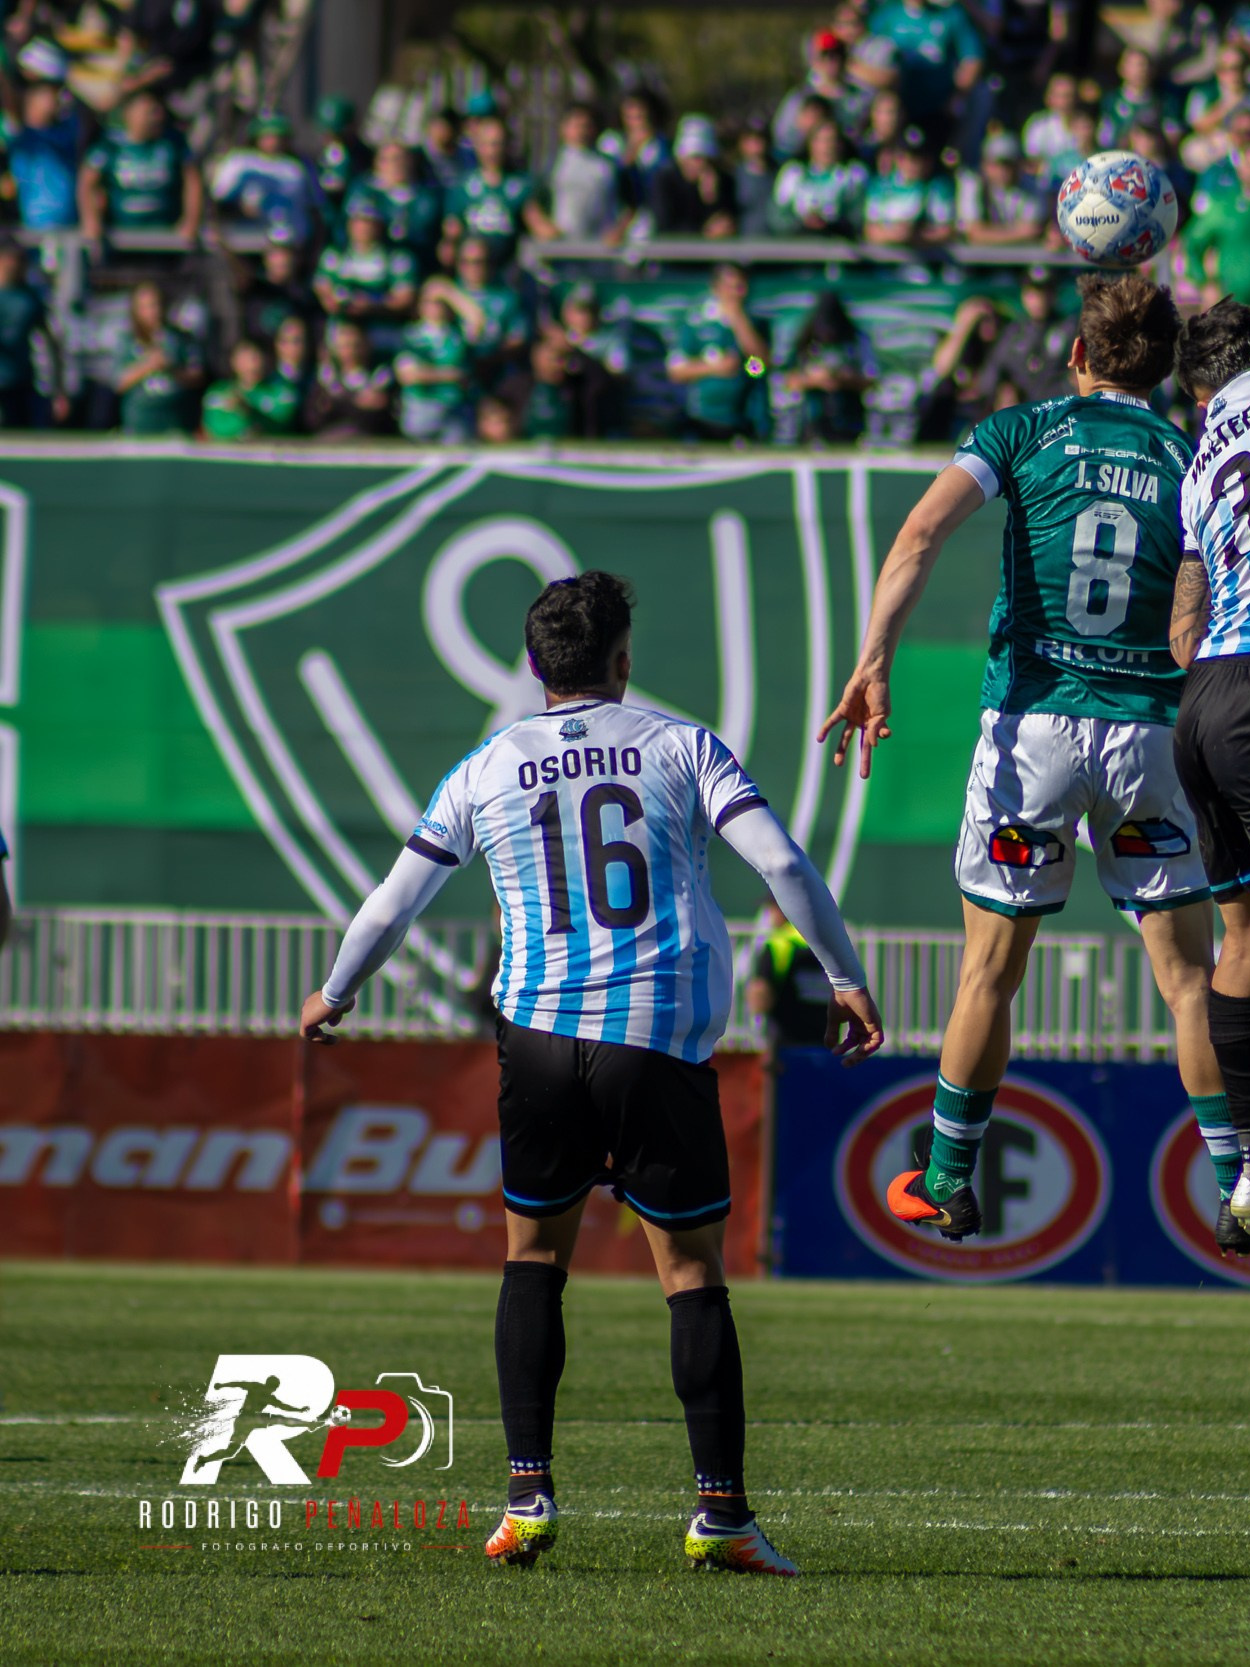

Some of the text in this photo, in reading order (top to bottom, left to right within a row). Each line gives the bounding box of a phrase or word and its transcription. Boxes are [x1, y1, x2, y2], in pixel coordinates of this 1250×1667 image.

[1075, 213, 1120, 227] molten
[1075, 461, 1158, 504] J. SILVA
[1066, 500, 1138, 636] 8
[1035, 638, 1149, 663] RICOH
[518, 747, 642, 791] OSORIO
[530, 783, 650, 935] 16
